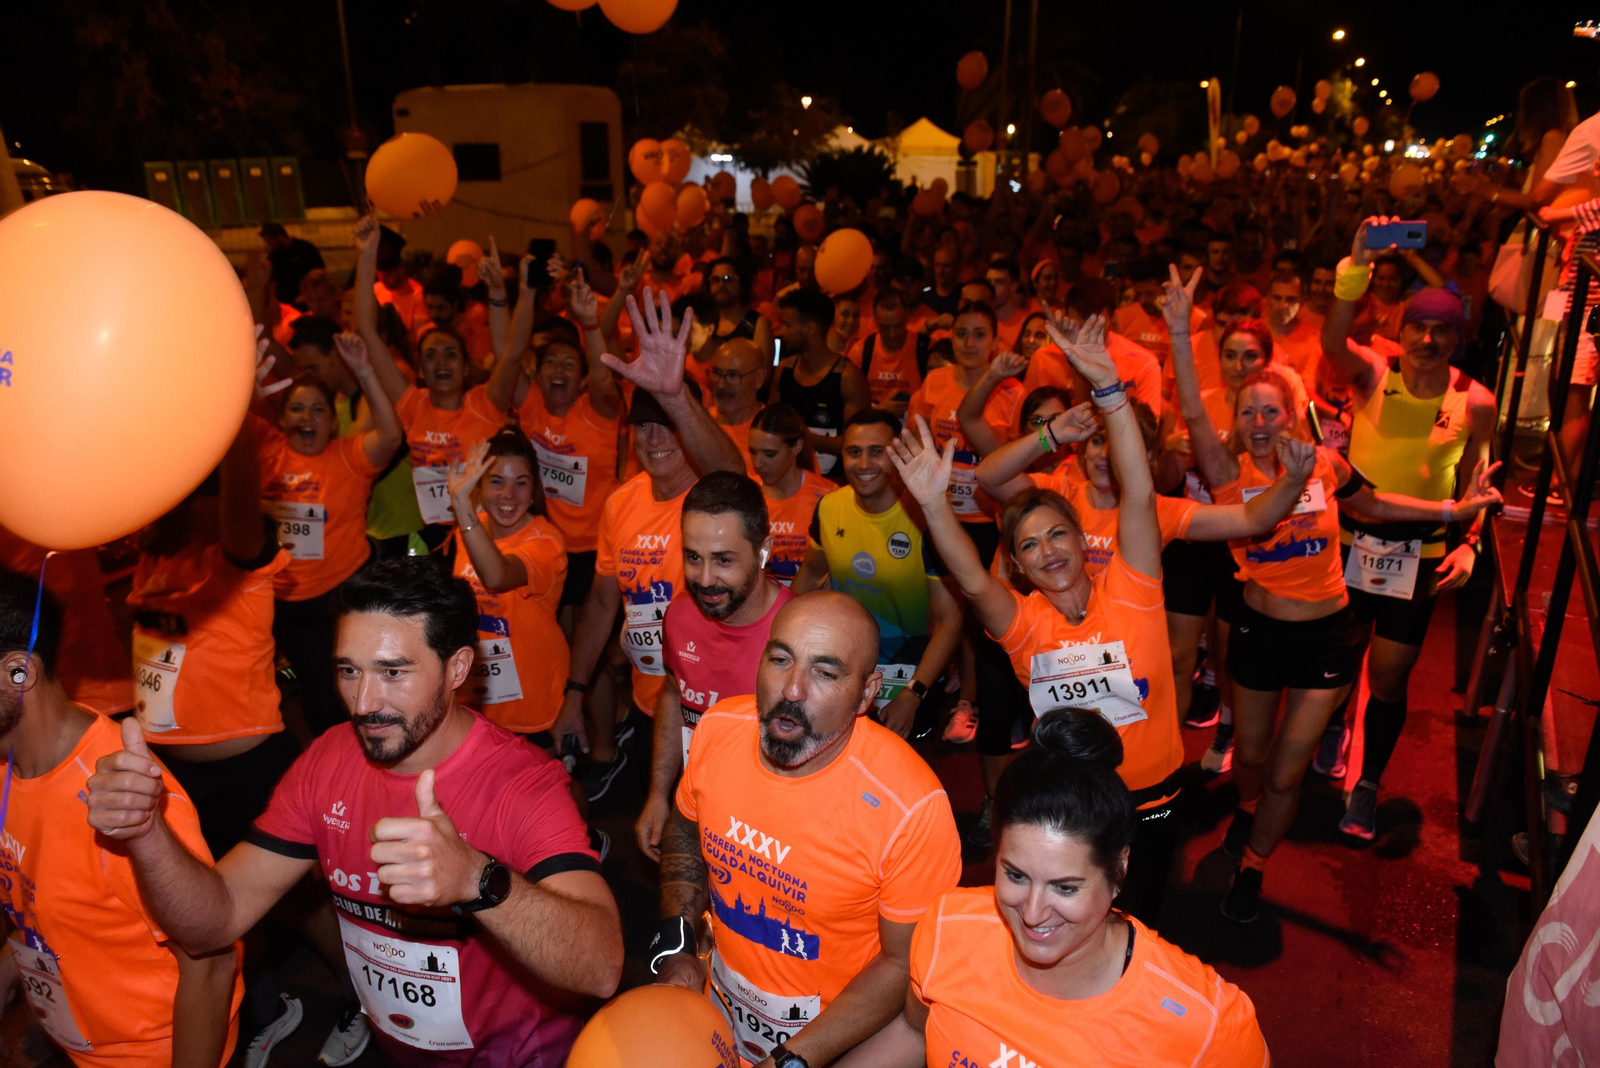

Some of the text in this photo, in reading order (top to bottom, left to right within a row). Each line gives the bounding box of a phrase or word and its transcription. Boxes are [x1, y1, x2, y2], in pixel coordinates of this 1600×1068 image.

[542, 466, 574, 486] 7500
[428, 484, 451, 498] 17
[947, 483, 972, 496] 653
[634, 534, 671, 549] XXXV
[1362, 554, 1403, 571] 11871
[1048, 676, 1111, 703] 13911
[725, 815, 792, 865] XXXV
[703, 826, 809, 891] CARRERA NOCTURNA
[706, 842, 807, 904] GUADALQUIVIR
[333, 895, 383, 921] CLUB DE
[362, 963, 437, 1008] 17168
